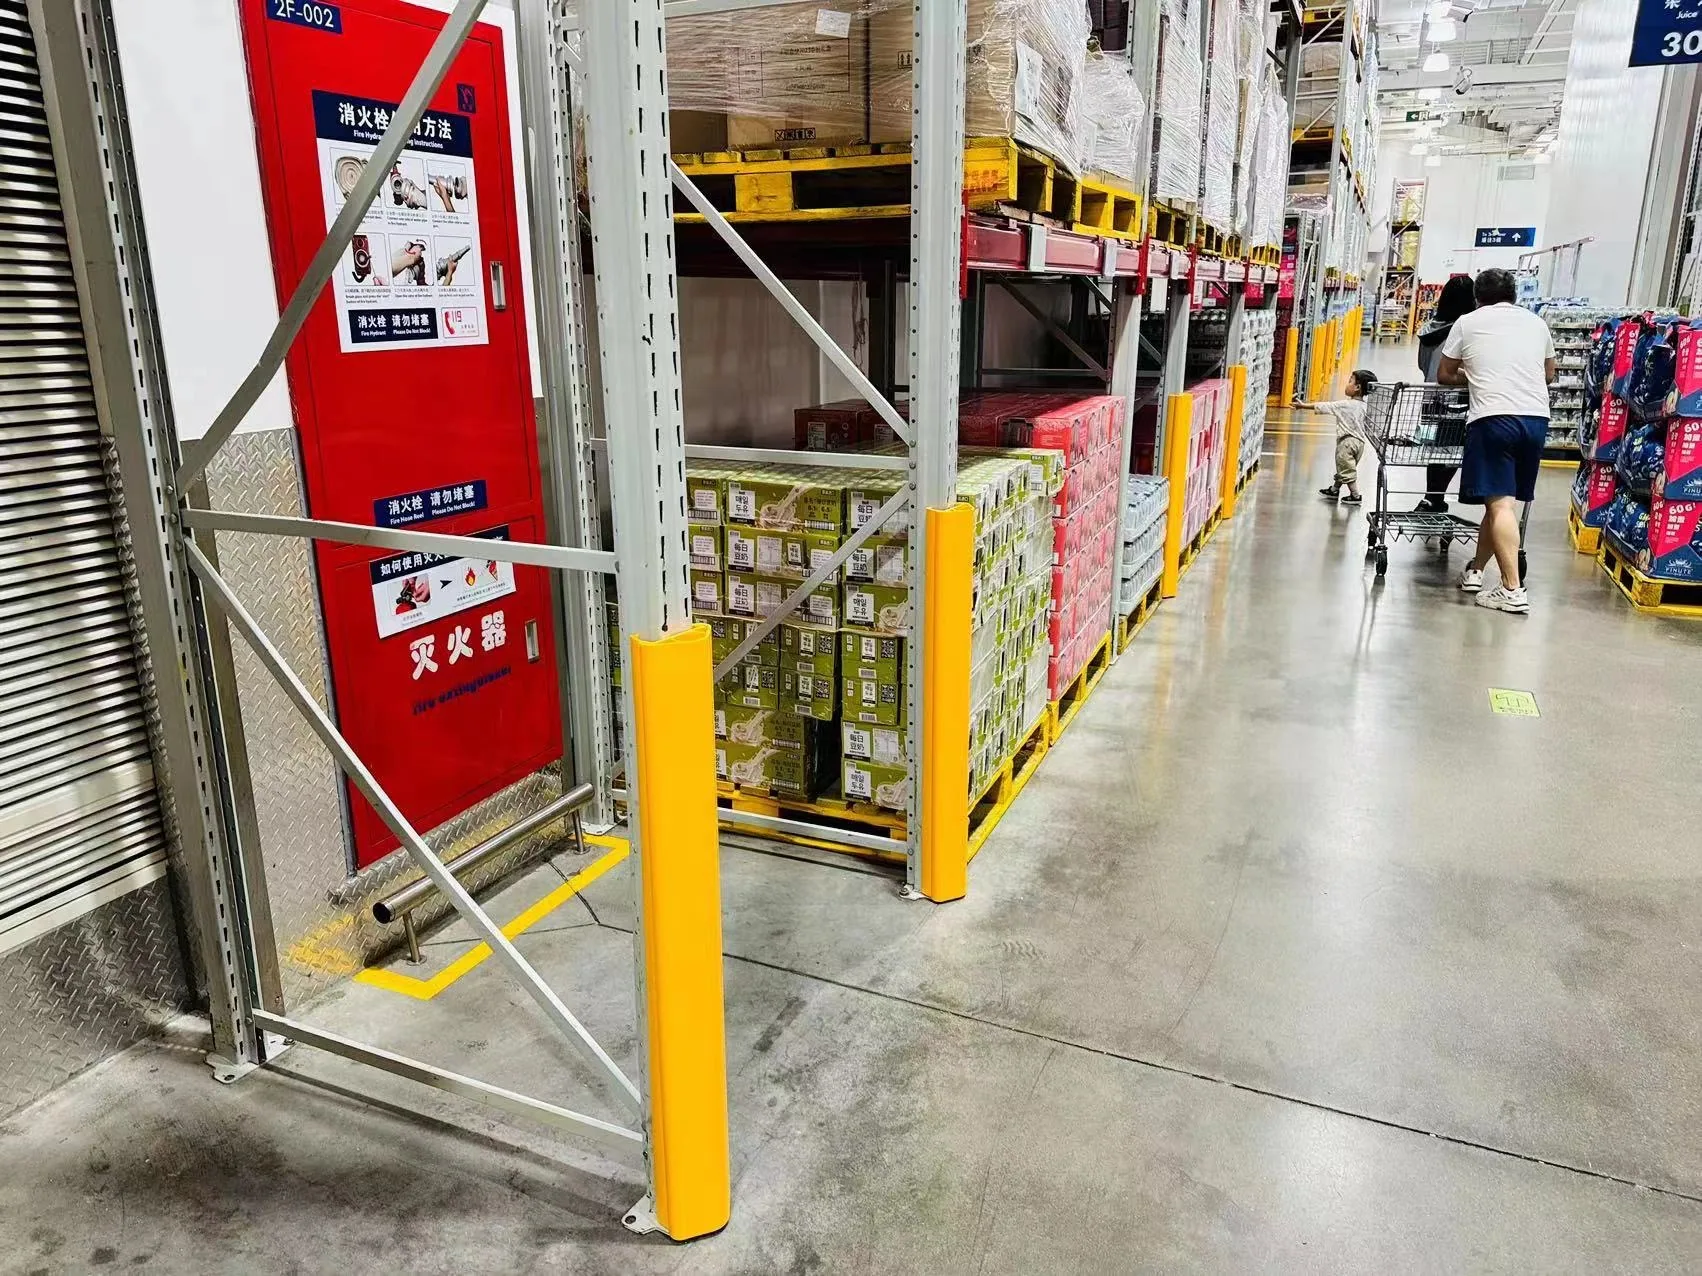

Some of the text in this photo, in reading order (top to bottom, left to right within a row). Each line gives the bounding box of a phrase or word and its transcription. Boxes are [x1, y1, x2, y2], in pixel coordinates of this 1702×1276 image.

[275, 0, 334, 28] 2F-002
[1676, 9, 1699, 19] Juice
[1661, 29, 1702, 57] 30
[353, 129, 365, 138] Fire
[358, 313, 430, 329] 消火栓 请勿堵塞
[388, 484, 475, 516] 消火栓 请勿堵塞
[857, 504, 873, 514] 每日
[1669, 502, 1696, 514] 60G!
[390, 517, 400, 525] Fire
[400, 514, 413, 523] Hose
[413, 512, 424, 520] Reel
[432, 508, 447, 516] Please
[734, 542, 748, 552] 每日
[734, 552, 749, 562] 豆奶
[852, 553, 867, 563] 每日
[853, 563, 867, 572] 豆奶
[734, 587, 748, 597] 每日
[853, 607, 866, 616] 두유
[410, 610, 506, 680] 灭火器
[850, 733, 863, 743] 每日
